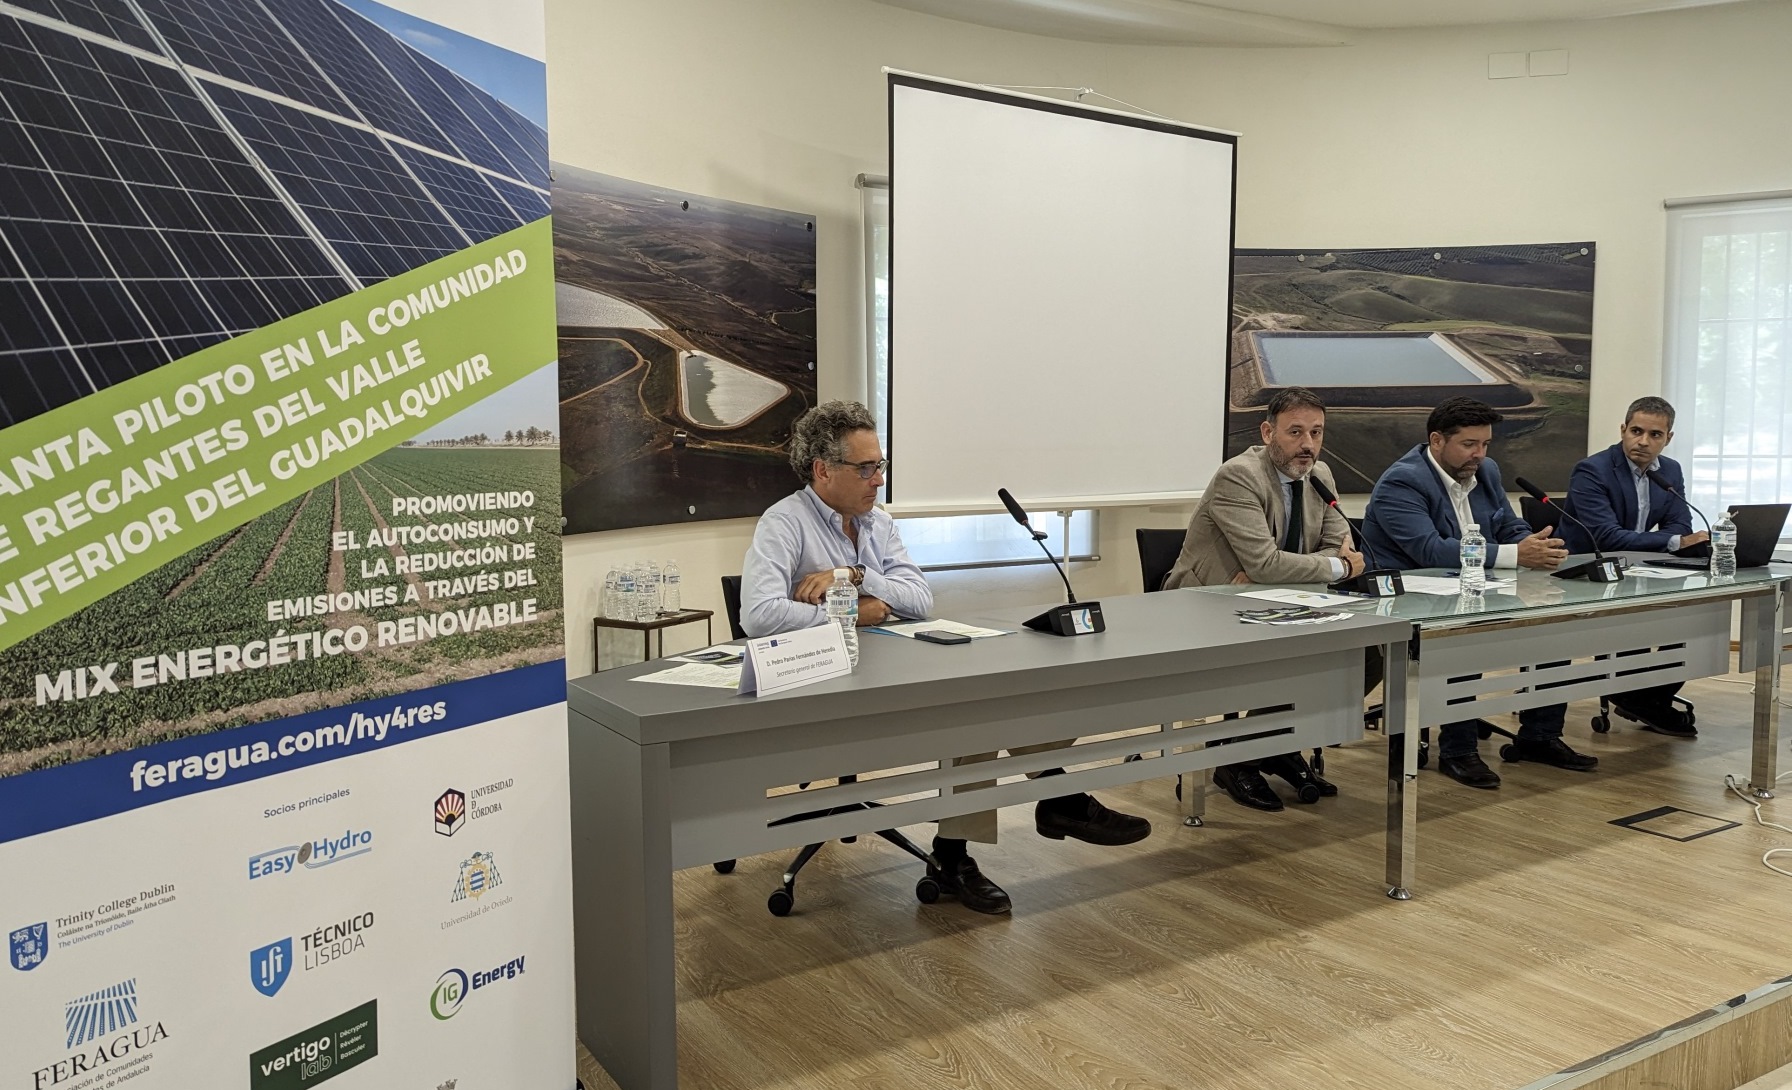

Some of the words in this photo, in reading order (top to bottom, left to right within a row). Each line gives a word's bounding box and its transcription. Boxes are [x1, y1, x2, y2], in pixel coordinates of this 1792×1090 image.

[113, 364, 255, 446] PILOTO
[260, 338, 315, 382] EN
[316, 320, 365, 358] LA
[367, 249, 527, 335] COMUNIDAD
[22, 419, 249, 546] REGANTES
[252, 388, 326, 438] DEL
[325, 339, 426, 402] VALLE
[184, 468, 266, 523] DEL
[269, 353, 493, 480] GUADALQUIVIR
[392, 490, 534, 516] PROMOVIENDO
[332, 531, 360, 551] EL
[366, 517, 519, 548] AUTOCONSUMO
[523, 516, 535, 533] Y
[361, 559, 389, 578] LA
[395, 543, 507, 574] REDUCCIÓN
[513, 542, 536, 560] DE
[267, 586, 397, 621] EMISIONES
[403, 583, 420, 603] A
[425, 570, 499, 599] TRAVÉS
[504, 568, 537, 589] DEL
[35, 662, 120, 706] MIX
[132, 625, 369, 688] ENERGÉTICO
[378, 598, 537, 647] RENOVABLE
[796, 665, 810, 674] general
[815, 659, 833, 667] FERAGUA
[130, 700, 447, 792] feragua.com/hy4res
[264, 803, 296, 818] Socios
[298, 788, 350, 811] principales
[471, 778, 514, 799] UNIVERSIDAD
[471, 802, 503, 820] CÓRDOBA
[249, 853, 295, 880] Easy
[313, 830, 372, 859] Hydro
[55, 909, 95, 928] Trinity
[98, 896, 137, 915] College
[140, 883, 175, 901] Dublin
[127, 906, 142, 916] Baile
[440, 908, 481, 930] Universidad
[482, 904, 491, 914] de
[491, 895, 513, 910] Oviedo
[58, 940, 71, 949] The
[73, 929, 105, 944] University
[106, 925, 113, 933] of
[114, 919, 134, 931] Dublin
[301, 912, 374, 951] TÉCNICO
[305, 934, 365, 971] LISBOA
[443, 983, 458, 1004] IG
[472, 955, 525, 990] Energy
[32, 1021, 170, 1090] FERAGUA
[95, 1073, 104, 1082] de
[106, 1052, 153, 1077] Comunidades
[261, 1036, 331, 1076] vertigo
[301, 1054, 332, 1080] lab
[340, 1043, 366, 1060] Basculer
[106, 1080, 115, 1088] de
[117, 1064, 150, 1084] Andalucía
